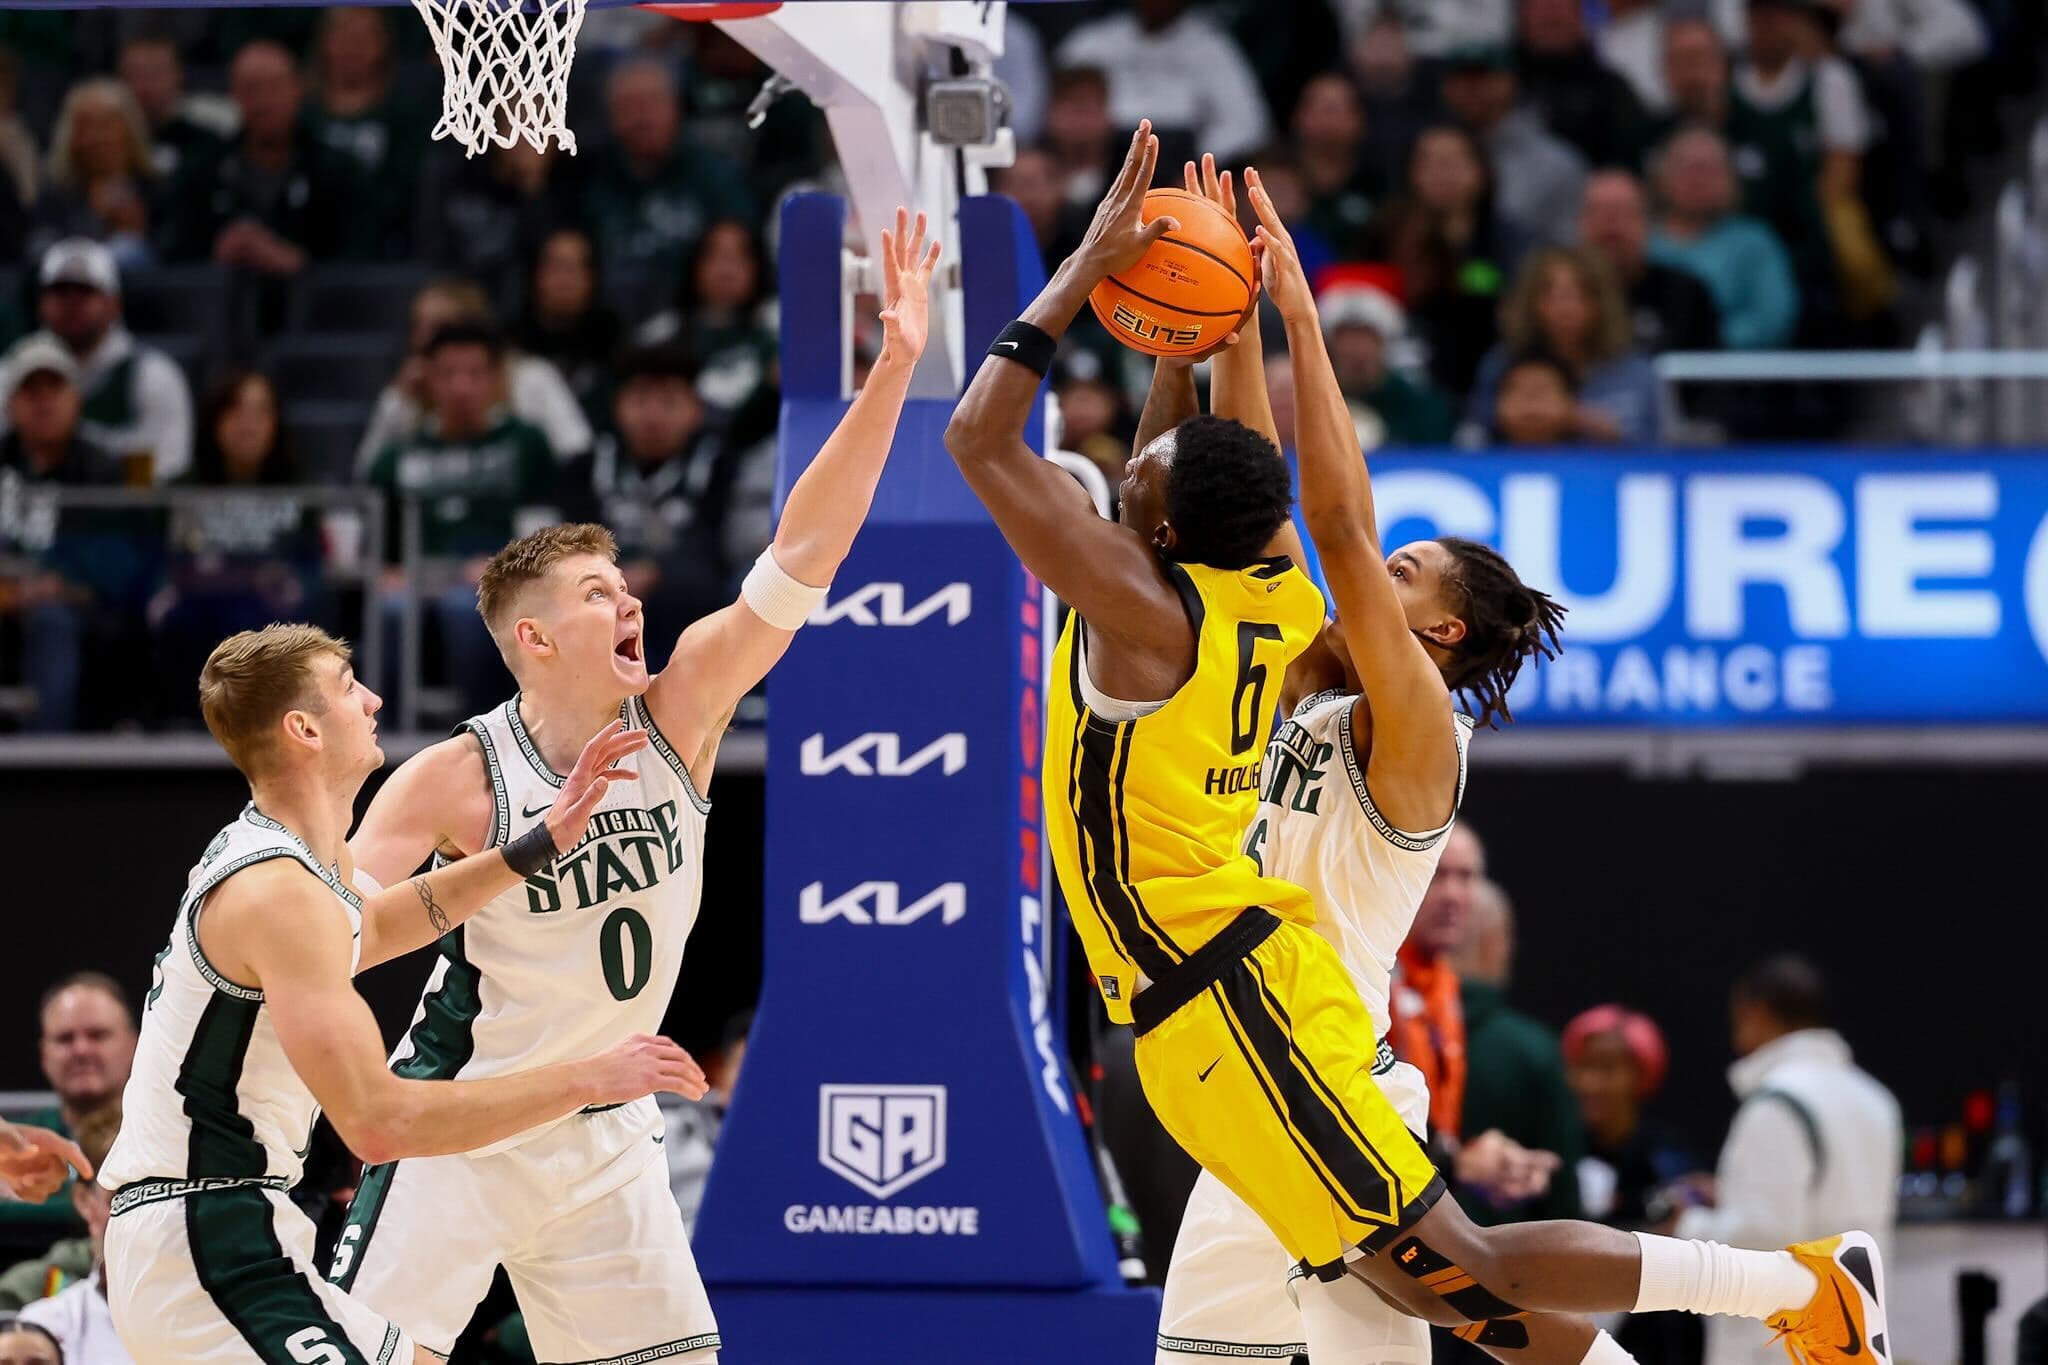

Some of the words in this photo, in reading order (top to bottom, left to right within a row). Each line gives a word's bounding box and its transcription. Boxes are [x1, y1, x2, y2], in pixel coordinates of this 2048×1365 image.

[1112, 303, 1200, 345] ELITE
[800, 732, 967, 776] KIA
[524, 799, 684, 914] STATE
[799, 881, 967, 925] KIA
[599, 907, 653, 1002] 0
[783, 1204, 979, 1236] GAMEABOVE
